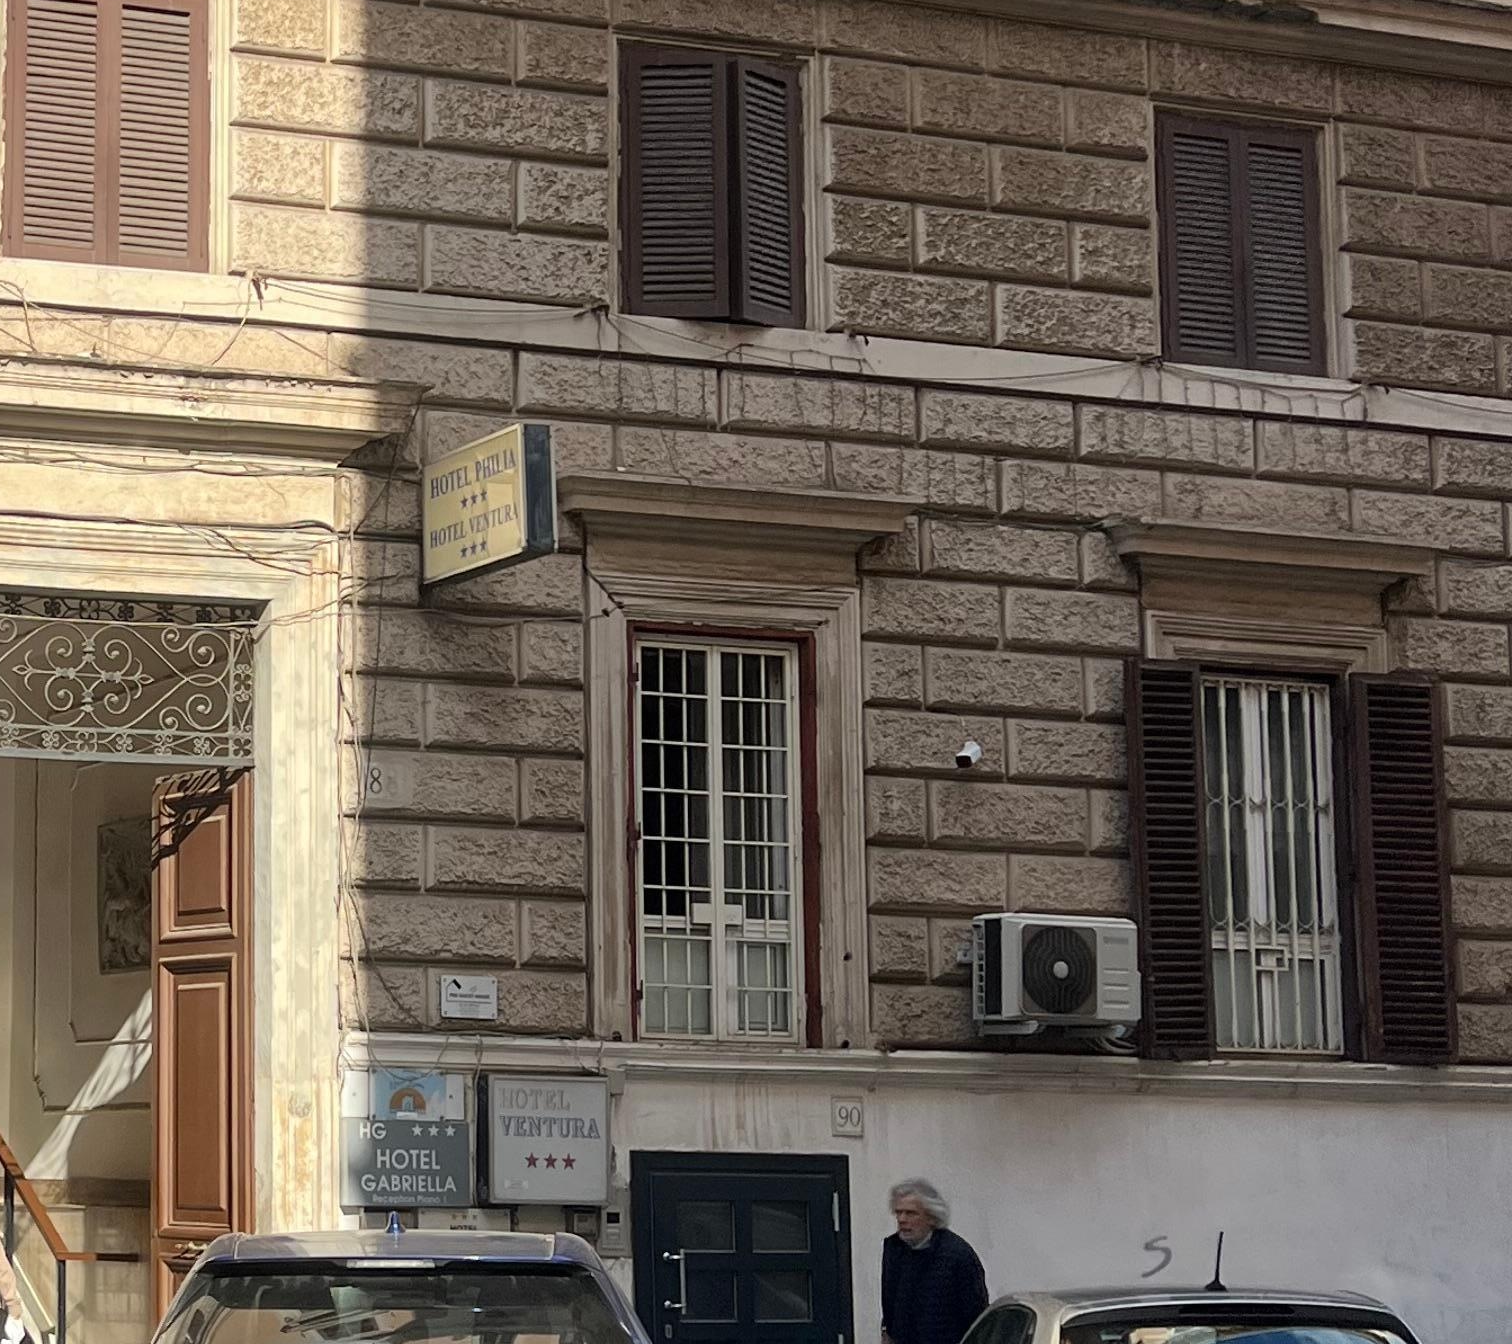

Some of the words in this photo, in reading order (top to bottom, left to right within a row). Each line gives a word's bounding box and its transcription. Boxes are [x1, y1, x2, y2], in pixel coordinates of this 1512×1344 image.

[431, 466, 472, 499] HOTEL
[475, 447, 517, 482] PHILIA
[430, 521, 468, 549] HOTEL
[469, 501, 519, 534] VENTURA
[498, 1087, 571, 1111] HOTEL
[499, 1115, 601, 1139] VENTURA
[837, 1105, 861, 1127] 90
[359, 1122, 387, 1139] HG
[376, 1148, 441, 1170] HOTEL
[360, 1174, 457, 1193] GABRIELLA
